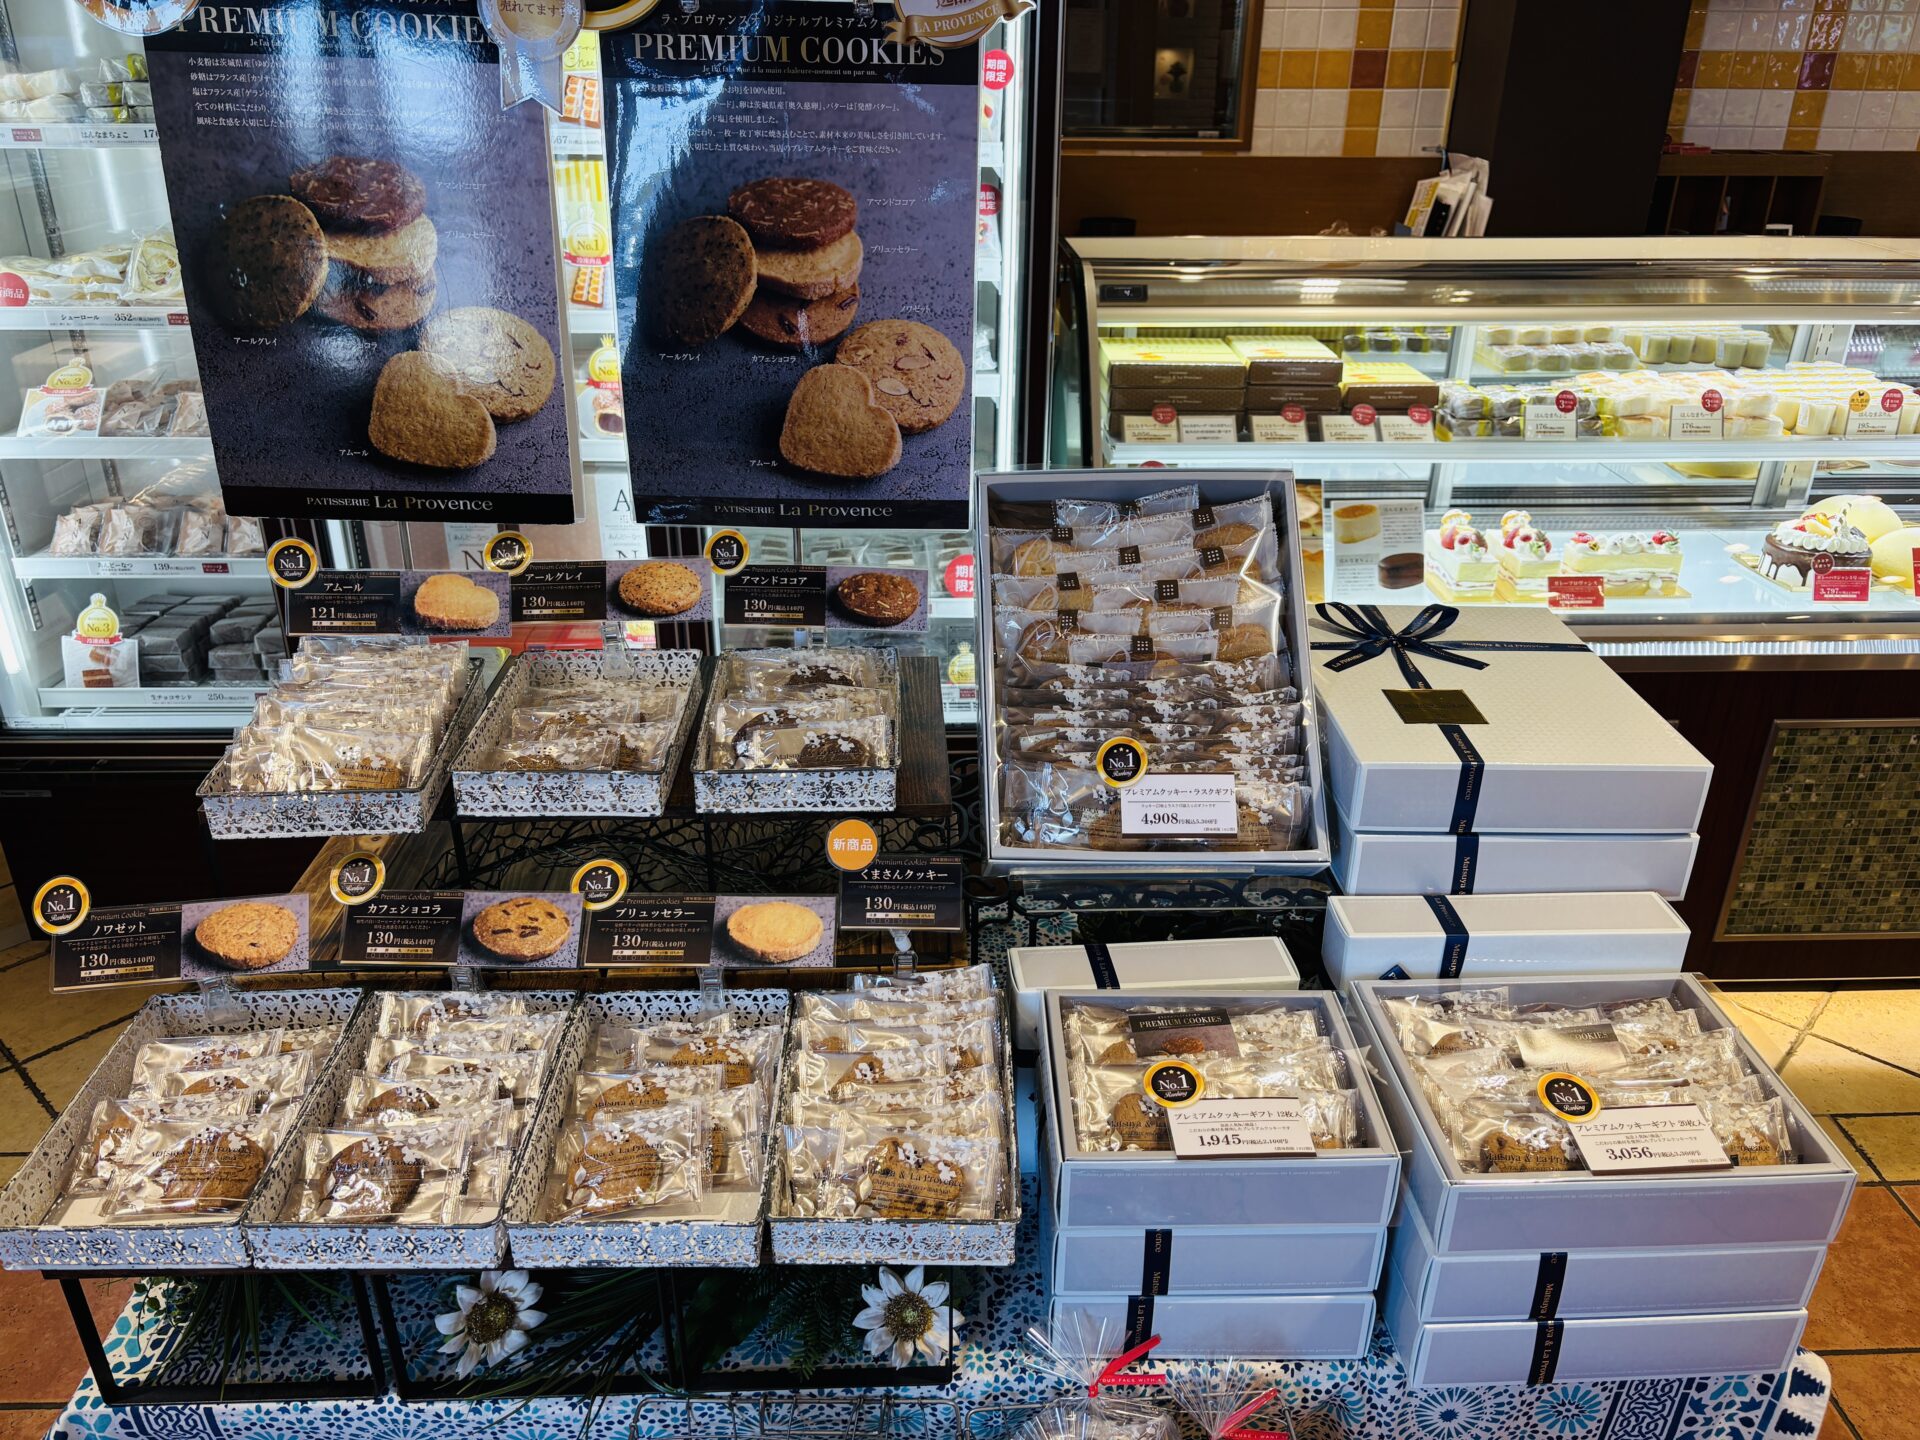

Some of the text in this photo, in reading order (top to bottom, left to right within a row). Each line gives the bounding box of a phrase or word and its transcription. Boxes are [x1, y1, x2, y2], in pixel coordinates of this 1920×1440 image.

[350, 10, 494, 43] COOKIE
[914, 20, 930, 33] LA
[632, 32, 945, 66] PREMIUM COOKIES
[986, 58, 1007, 70] 期間
[986, 71, 1007, 82] 限定
[866, 198, 916, 207] アマンドココア
[577, 239, 600, 251] No.1
[870, 245, 918, 254] ブリュッセラー
[0, 287, 25, 300] 商品
[60, 313, 100, 322] シューロール
[233, 335, 278, 347] アールグレイ
[659, 352, 702, 362] アールグレイ
[751, 353, 797, 364] カフェショコラ
[339, 448, 369, 457] アムール
[749, 458, 778, 468] アムール
[306, 494, 493, 512] PATISSERIE La Provence
[714, 503, 893, 517] PATISSERIE La Provence
[716, 543, 739, 558] No.1
[280, 553, 305, 569] No.1
[525, 572, 583, 582] アールグレイ
[741, 575, 808, 585] アマンドココア
[323, 582, 364, 592] アムール
[86, 622, 110, 634] No.3
[1108, 752, 1135, 769] No.1
[1124, 787, 1235, 798] プレミアムクッキー・ラスクギフト
[832, 837, 873, 852] 新商品
[344, 866, 371, 883] No.1
[861, 868, 948, 881] くまさんクッキー
[585, 874, 613, 891] No.1
[47, 894, 75, 913] No.1
[368, 903, 442, 915] カフェショコラ
[616, 907, 696, 919] ブリュッセラー
[92, 921, 147, 937] ノワゼット
[1140, 1018, 1182, 1028] PREMIUM
[1159, 1074, 1191, 1091] No.1
[1552, 1087, 1584, 1104] No.1
[1175, 1110, 1274, 1121] プレミアムクッキーギフト
[1575, 1118, 1676, 1132] プレミアムクッキーギフト
